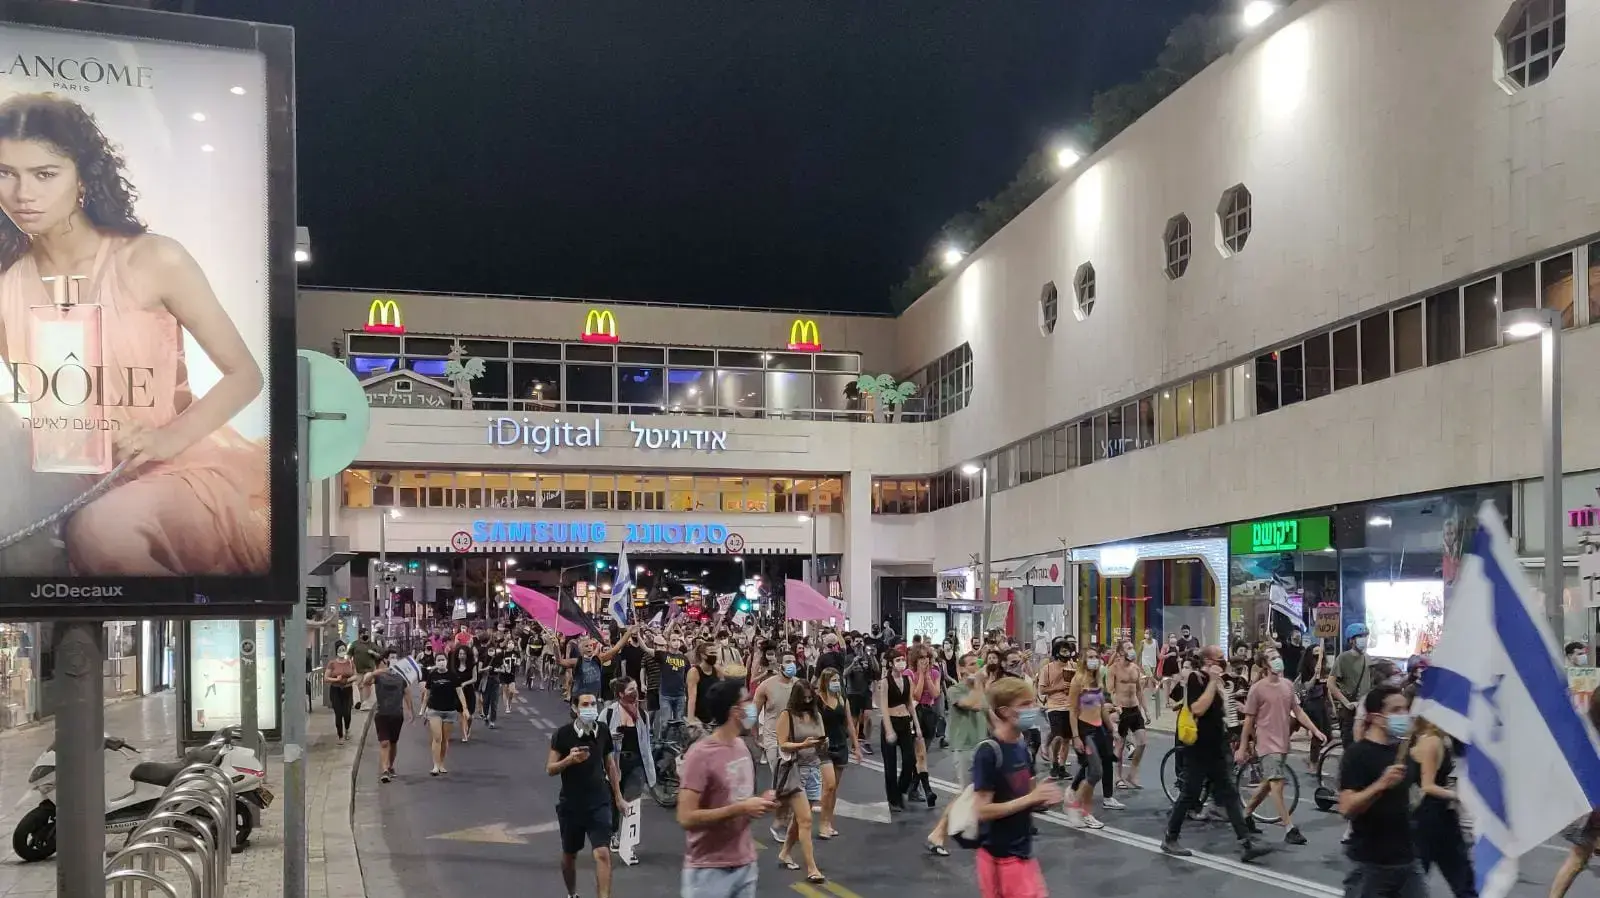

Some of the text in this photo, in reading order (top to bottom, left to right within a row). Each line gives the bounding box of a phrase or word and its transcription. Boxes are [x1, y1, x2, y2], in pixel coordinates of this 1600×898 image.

[53, 82, 90, 92] PARIS
[417, 393, 445, 407] גשר
[21, 416, 121, 431] הבושם לאישה
[487, 416, 600, 453] iDigital
[630, 420, 727, 450] אידיגיטל
[472, 520, 606, 543] SAMSUNG
[625, 521, 729, 545] סמסונג
[30, 583, 123, 598] JCDecaux
